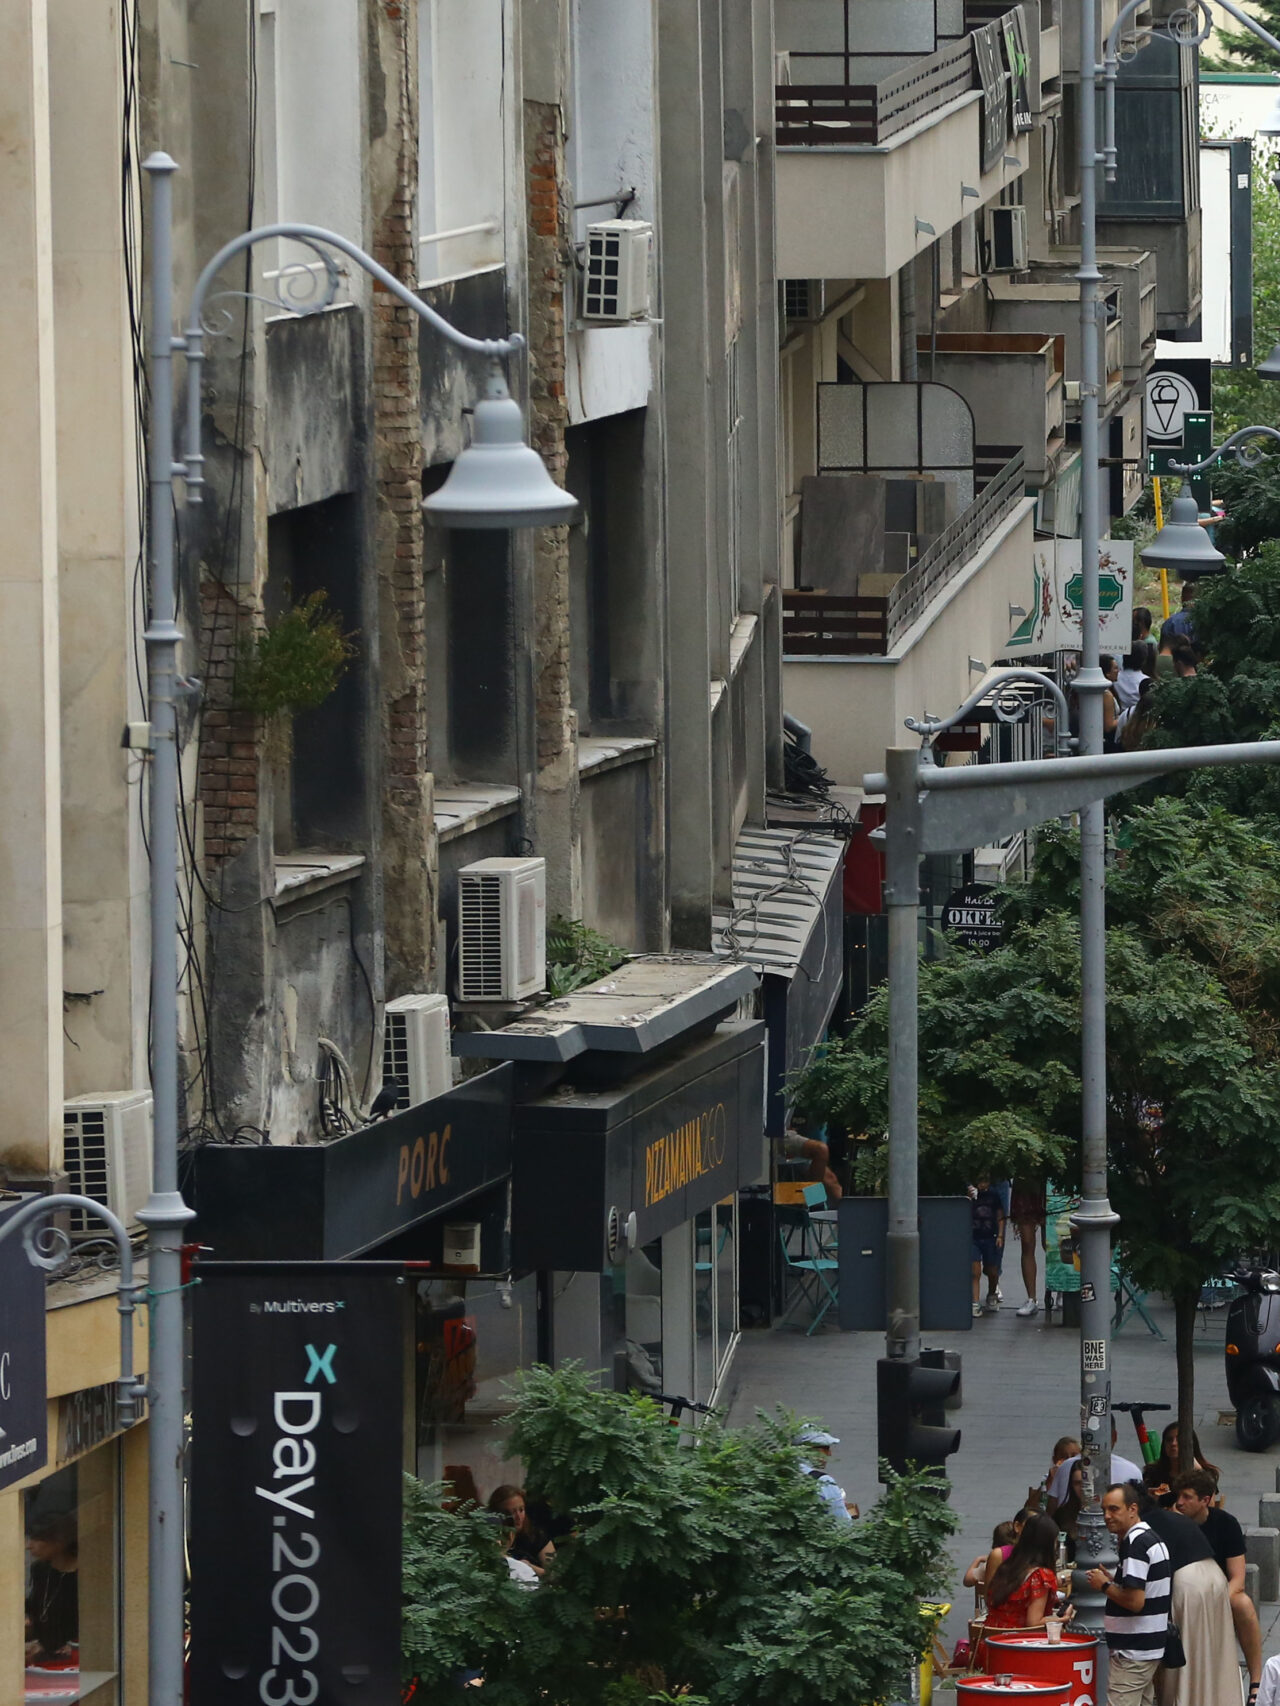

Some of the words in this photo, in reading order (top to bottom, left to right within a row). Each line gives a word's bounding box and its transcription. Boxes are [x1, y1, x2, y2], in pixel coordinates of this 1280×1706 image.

[949, 910, 1004, 925] OKFE
[978, 937, 990, 948] go
[397, 1124, 452, 1206] PORC
[1085, 1342, 1104, 1354] BNE
